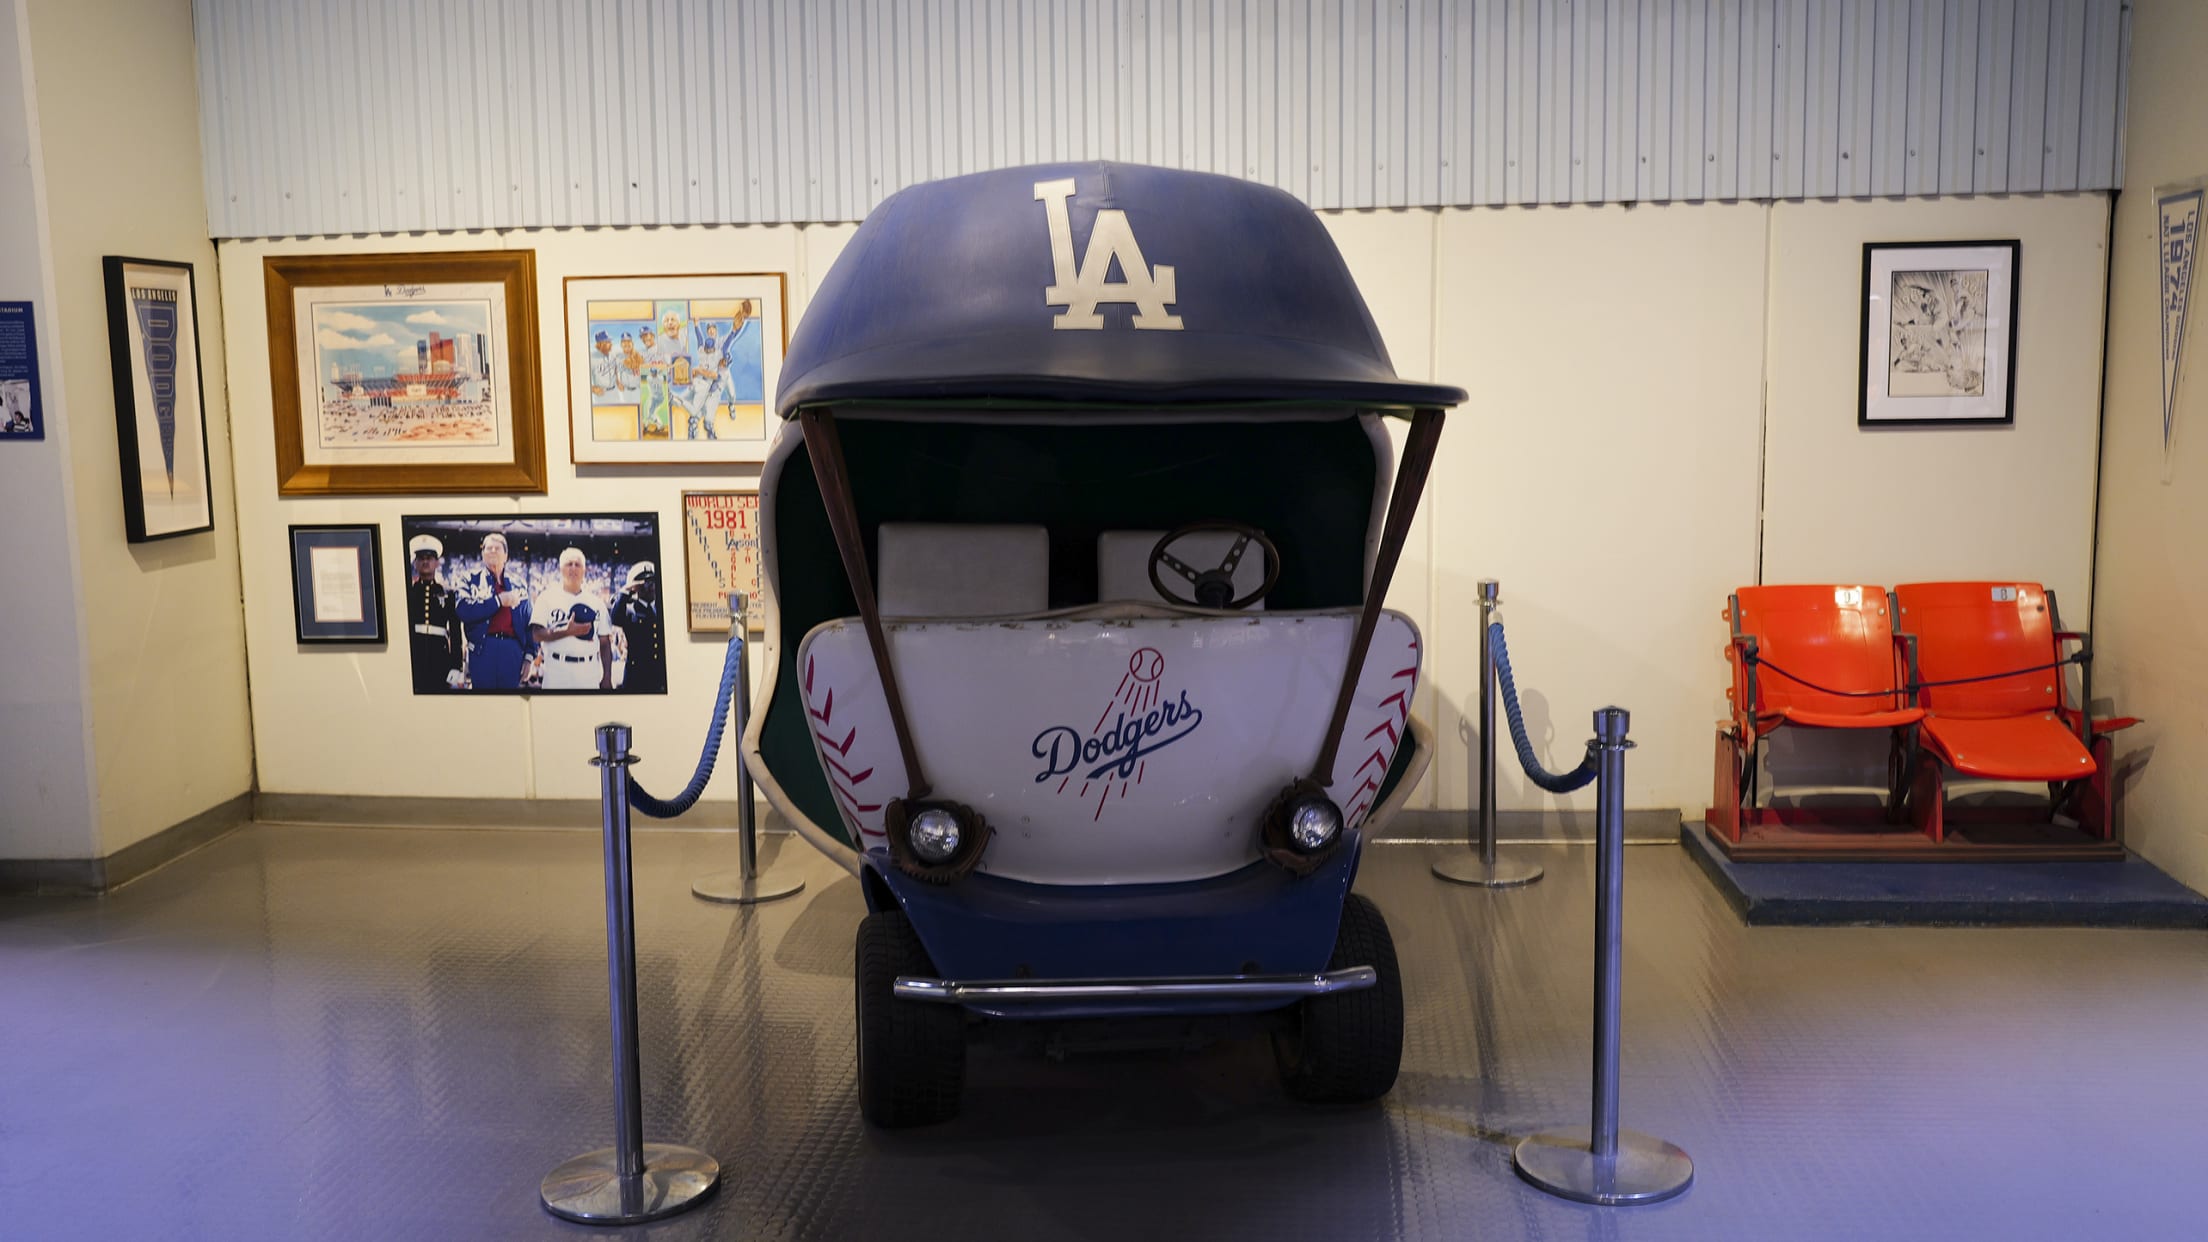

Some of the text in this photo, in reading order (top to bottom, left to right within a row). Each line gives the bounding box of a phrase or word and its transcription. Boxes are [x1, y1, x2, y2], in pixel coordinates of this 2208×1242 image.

[2185, 210, 2195, 244] LOS
[1034, 177, 1185, 331] LA
[2170, 218, 2186, 311] 1974
[131, 287, 176, 302] LOS ANGELES
[2178, 248, 2191, 312] ANGELES
[687, 495, 734, 509] WORLD
[704, 509, 747, 529] 1981
[1032, 689, 1203, 783] Dodgers
